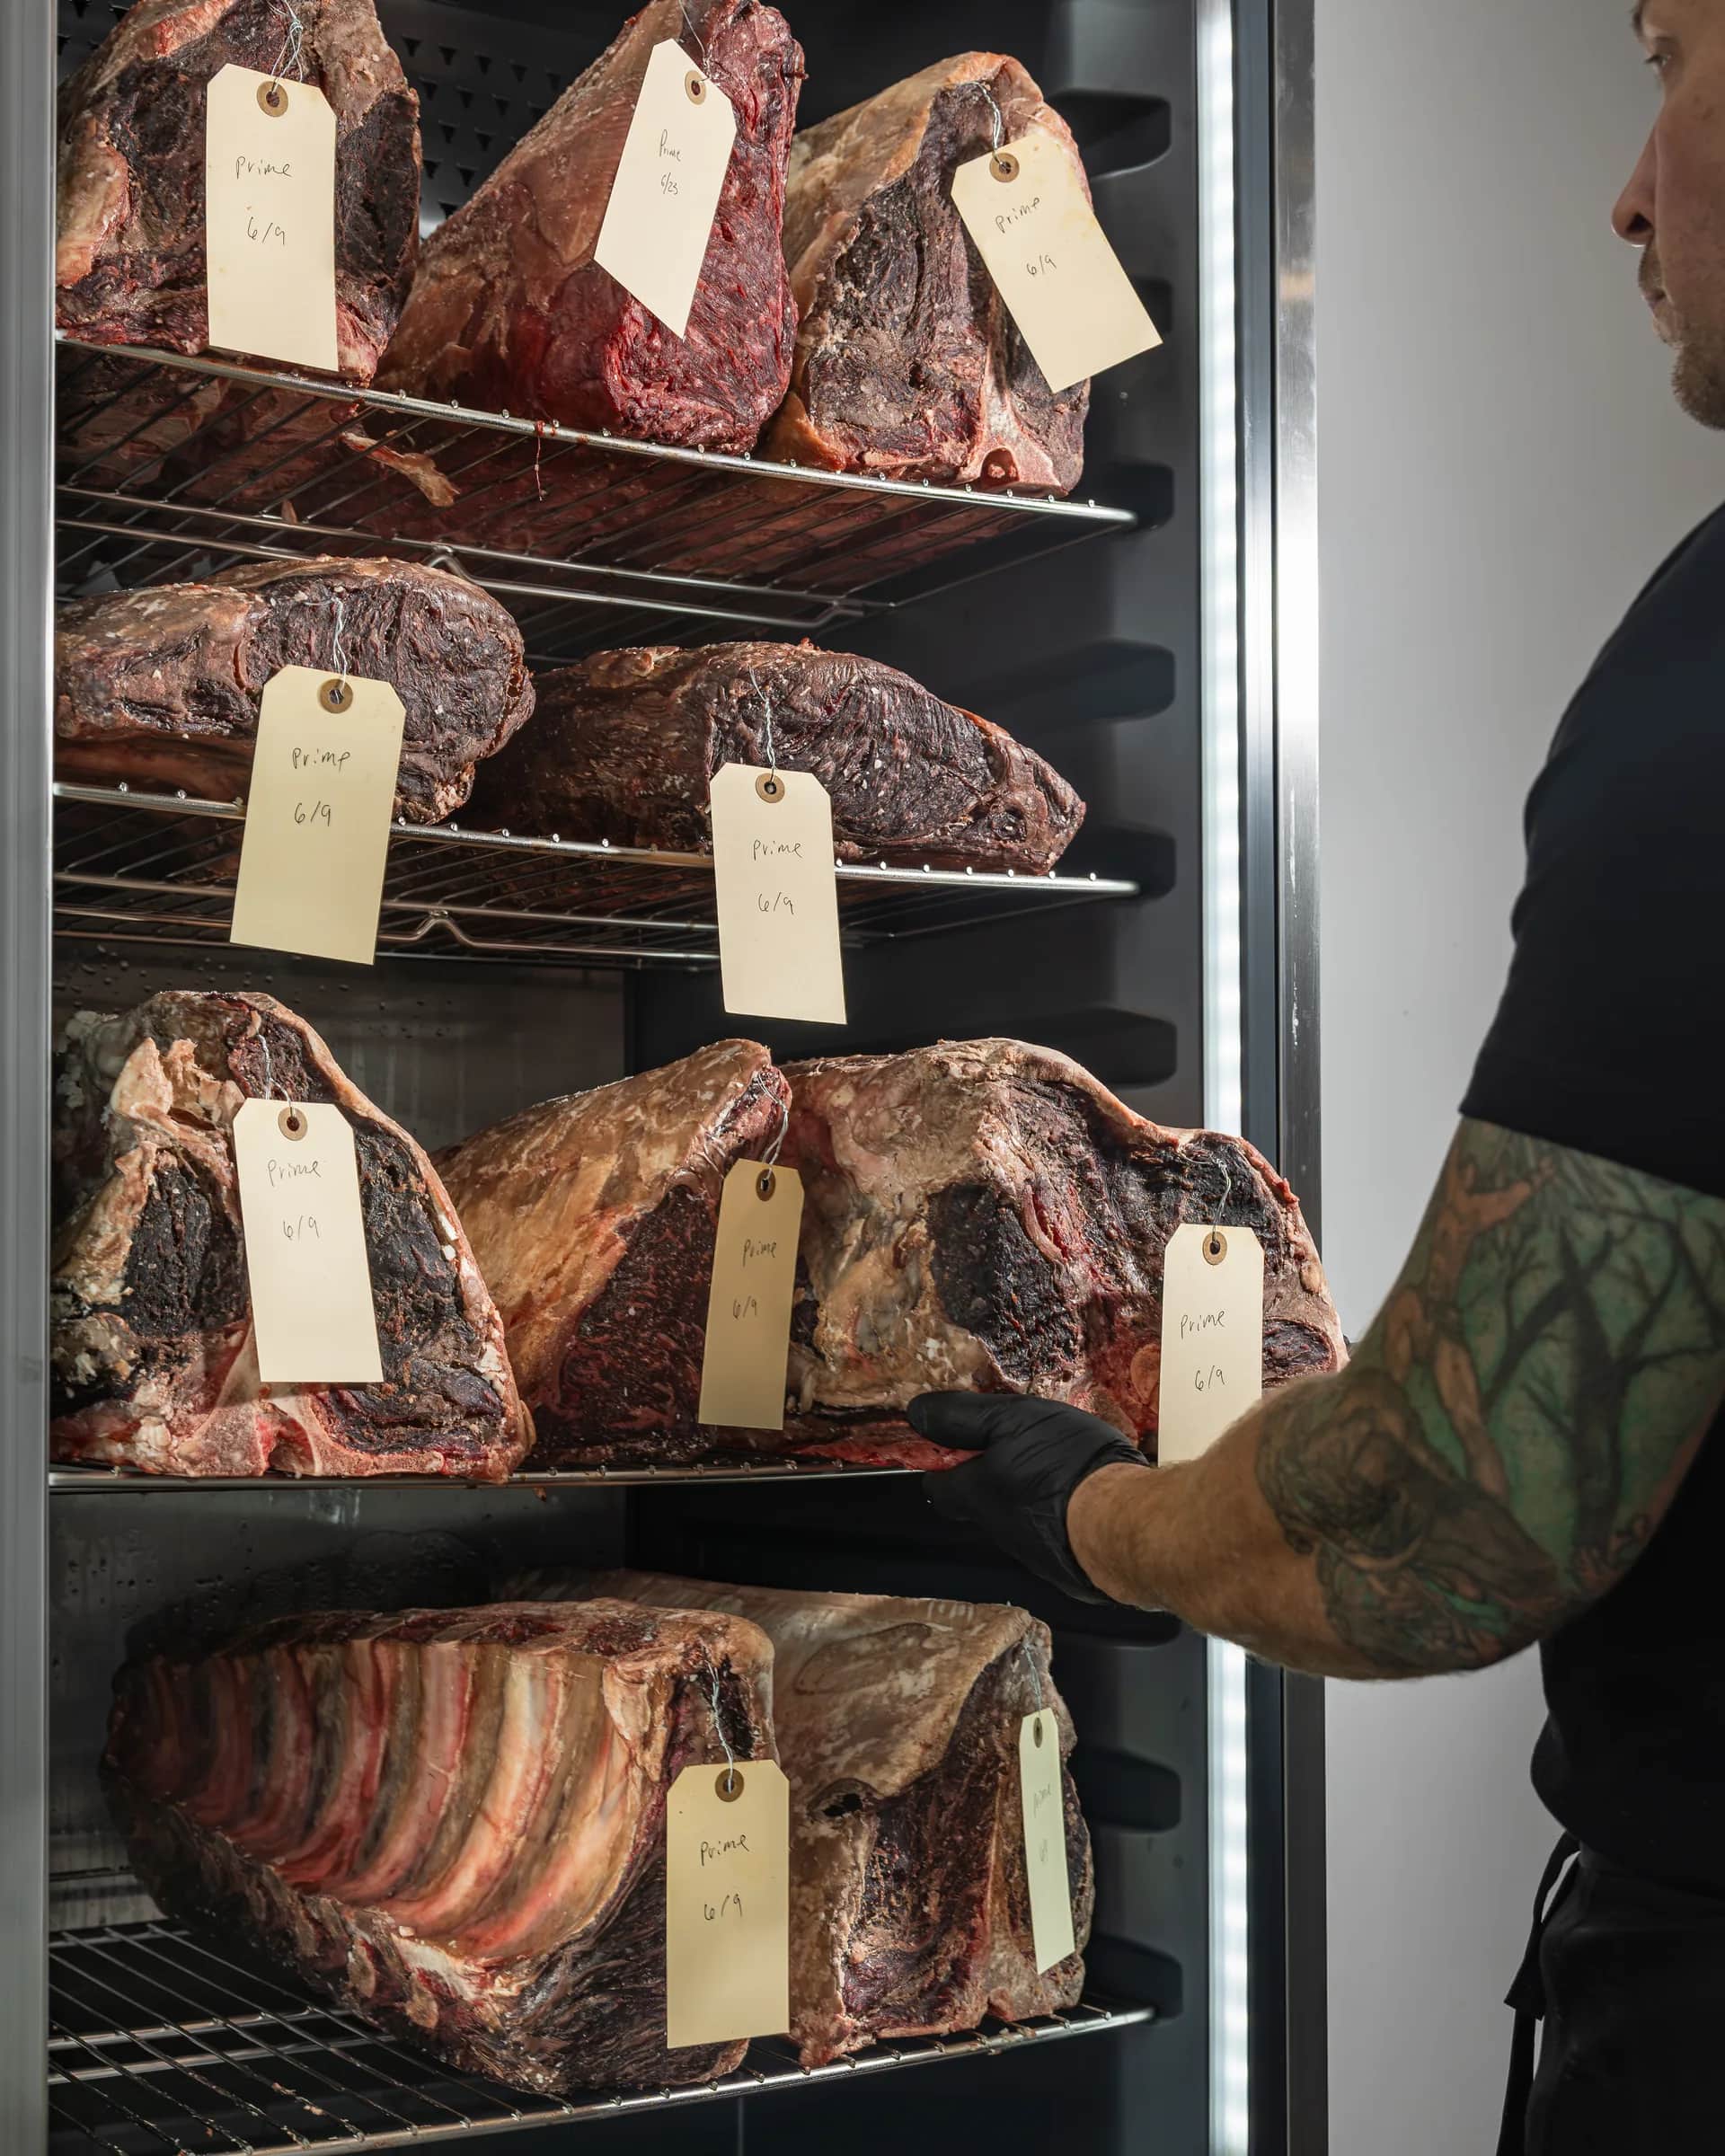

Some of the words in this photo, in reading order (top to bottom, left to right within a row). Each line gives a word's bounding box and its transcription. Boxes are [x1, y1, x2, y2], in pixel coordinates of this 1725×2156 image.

[659, 128, 681, 163] Prime
[235, 155, 292, 180] Prime
[246, 216, 286, 245] 6/9
[1026, 254, 1057, 278] 6/9
[294, 800, 332, 827] 6/9
[753, 838, 803, 862] Prime
[757, 891, 794, 915] 6/9
[282, 1215, 320, 1241] 6/9
[732, 1294, 757, 1321] 6/9
[1194, 1365, 1225, 1392] 6/9
[703, 1893, 743, 1922] 6/9
